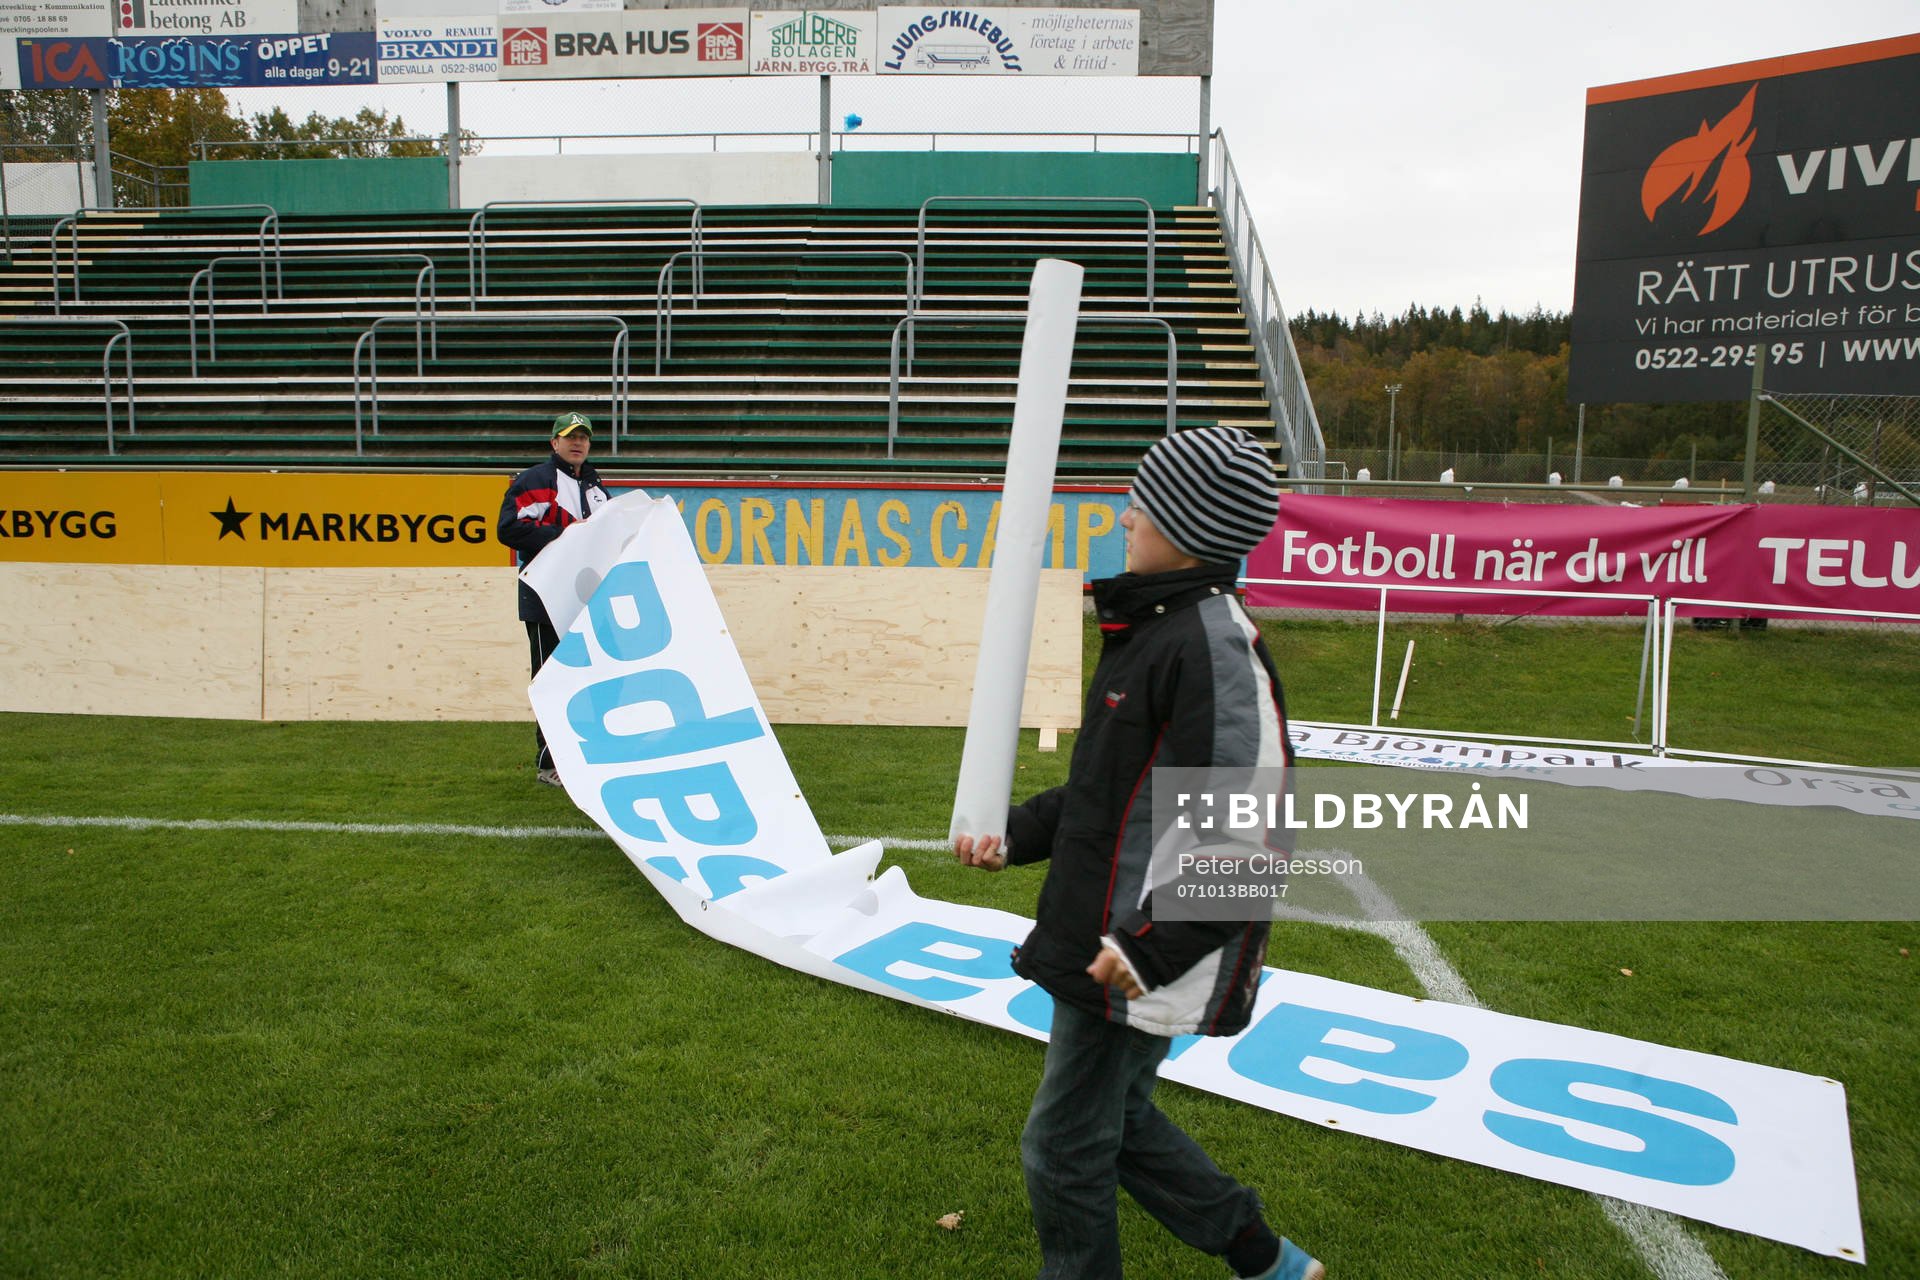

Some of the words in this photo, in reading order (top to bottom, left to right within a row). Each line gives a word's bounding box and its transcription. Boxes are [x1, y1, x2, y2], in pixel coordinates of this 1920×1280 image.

[150, 10, 212, 34] betong
[220, 10, 246, 28] AB
[384, 29, 432, 38] VOLVO
[445, 27, 494, 37] RENAULT
[771, 11, 857, 46] SOHLBERG
[1031, 13, 1134, 31] möjligheternas
[257, 33, 331, 60] ÖPPET
[381, 41, 497, 59] BRANDT
[511, 39, 540, 52] BRA
[554, 32, 618, 57] BRA
[626, 30, 690, 55] HUS
[705, 34, 736, 47] BRA
[705, 47, 737, 61] HUS
[771, 46, 856, 58] BOLAGEN
[885, 10, 1023, 72] LJUNGSKILEBUSS
[1030, 34, 1074, 52] företag
[1082, 35, 1087, 49] i
[1092, 34, 1134, 50] arbete
[31, 42, 106, 83] ICA
[118, 45, 241, 73] ROSINS
[265, 67, 286, 78] alla
[289, 67, 325, 80] dagar
[328, 58, 371, 77] 9-21
[381, 65, 434, 75] UDDEVALLA
[441, 63, 498, 74] 0522-81400
[511, 52, 541, 65] HUS
[1054, 55, 1065, 69] &
[1072, 54, 1108, 70] fritid
[1637, 260, 1750, 306] RÄTT
[1766, 250, 1920, 298] UTRUS
[1635, 317, 1656, 336] Vi
[1664, 314, 1705, 335] har
[1711, 306, 1850, 333] materialet
[1858, 304, 1897, 325] för
[1635, 345, 1756, 370] 0522-295
[1770, 342, 1804, 365] 95
[0, 510, 117, 539] KBYGG
[260, 512, 486, 543] MARKBYGG
[677, 497, 912, 568] ORNAS
[1283, 530, 1455, 580] Fotboll
[1475, 538, 1554, 583] när
[1566, 538, 1626, 584] du
[1642, 537, 1708, 584] vill
[1332, 732, 1646, 772] Björnpark
[1743, 768, 1912, 800] Orsa
